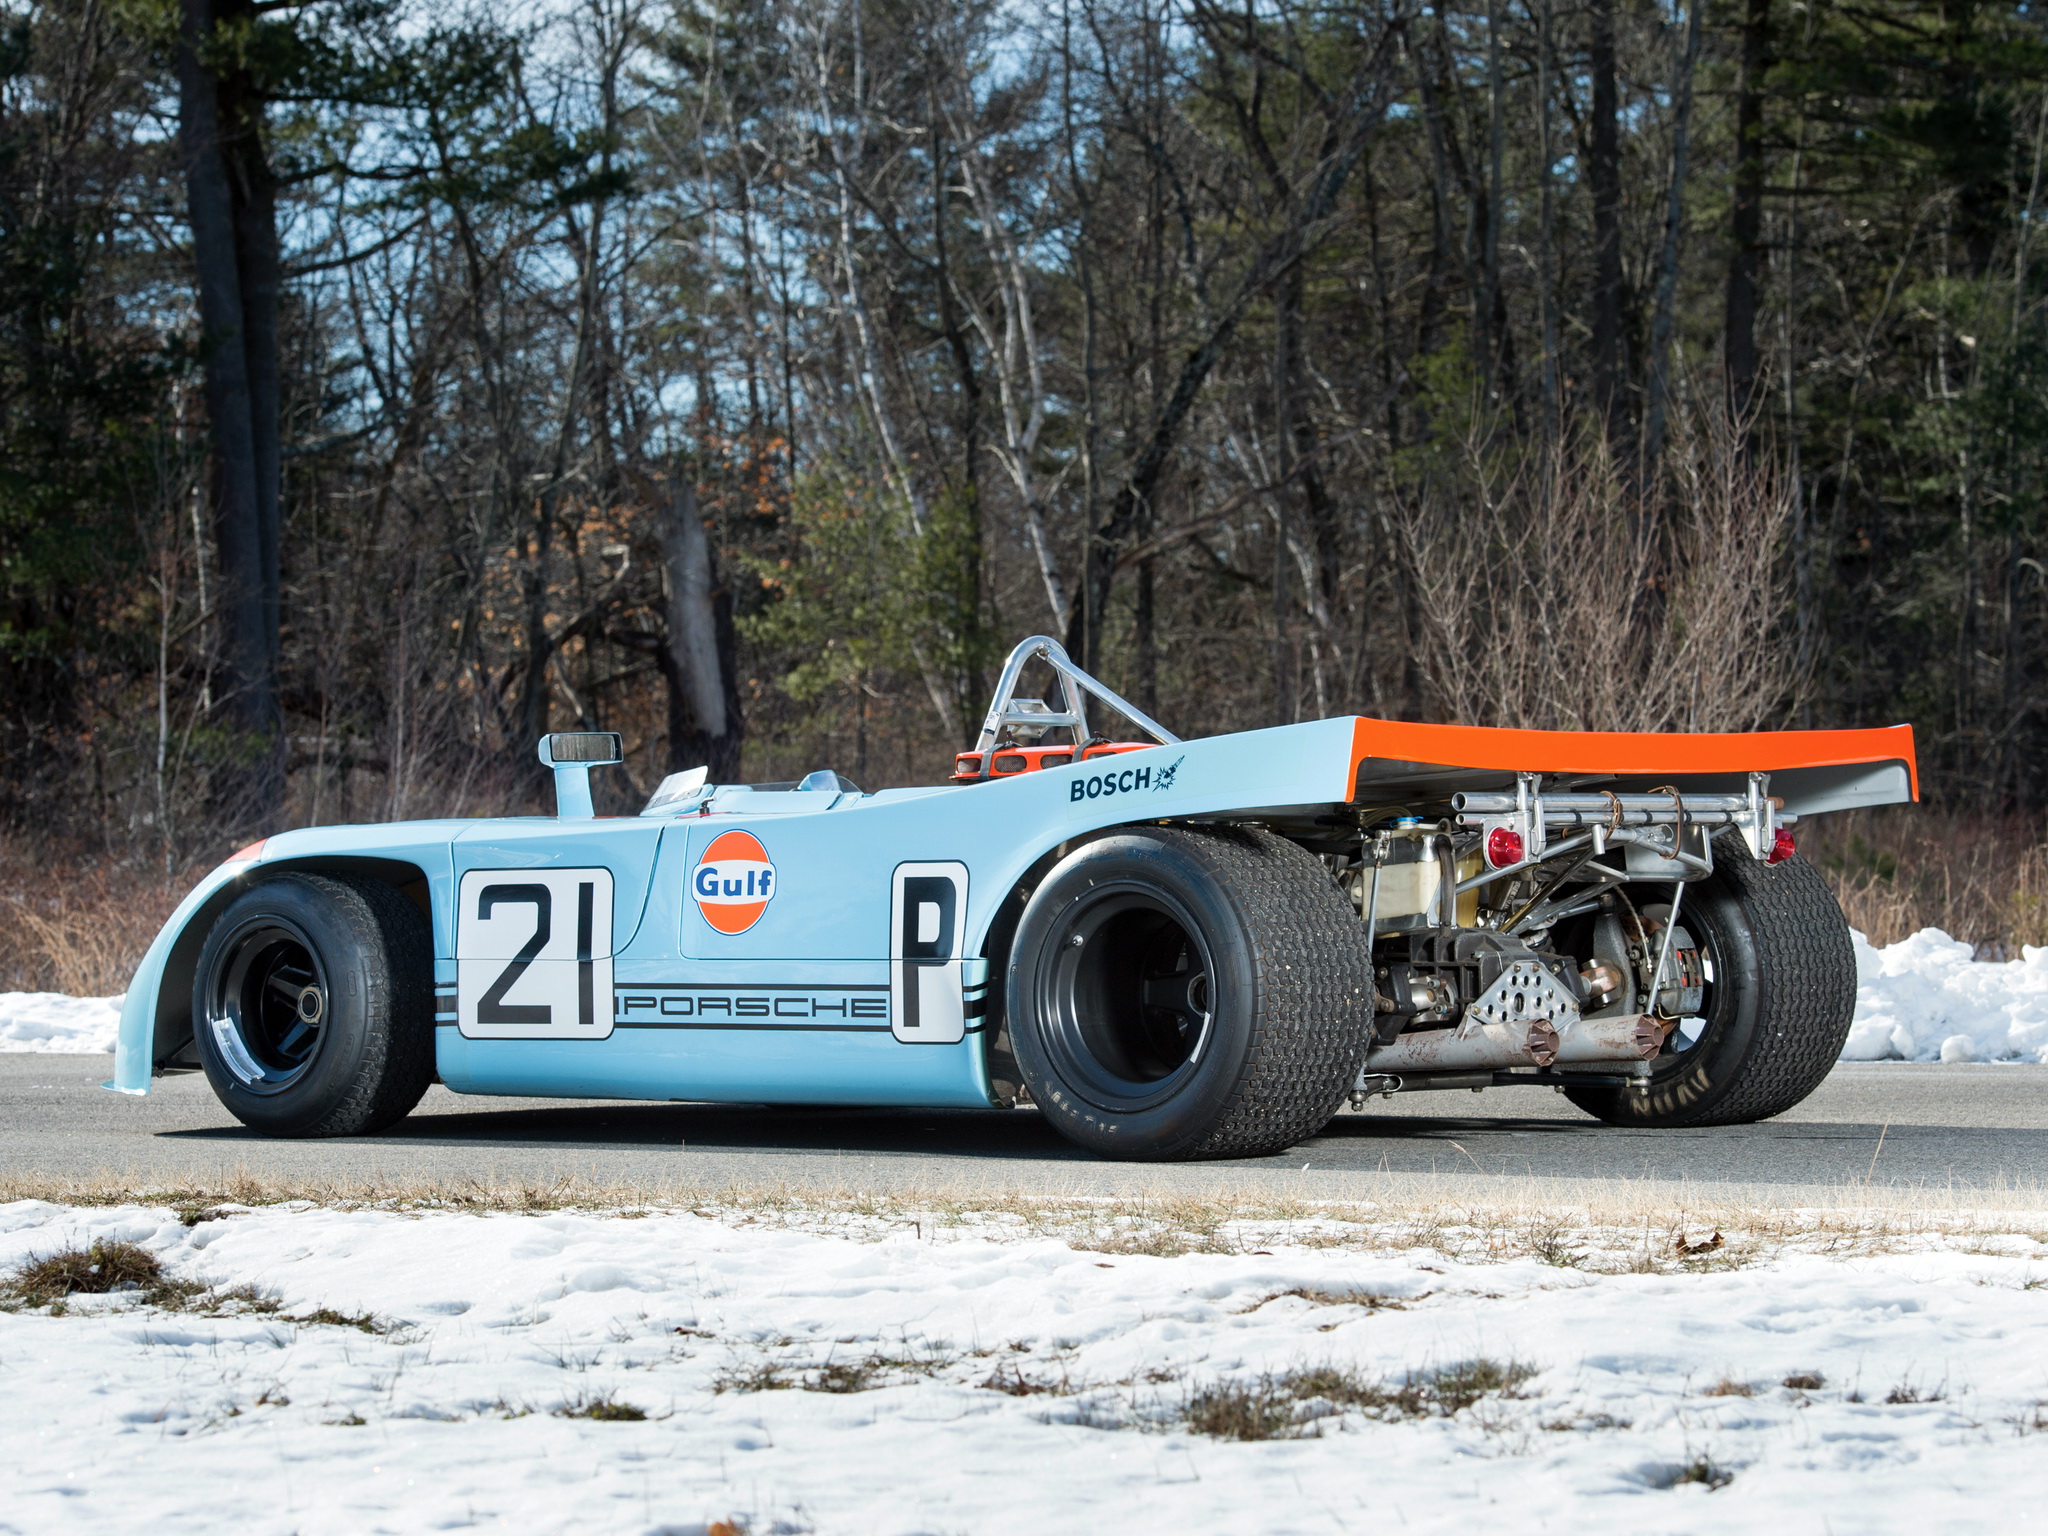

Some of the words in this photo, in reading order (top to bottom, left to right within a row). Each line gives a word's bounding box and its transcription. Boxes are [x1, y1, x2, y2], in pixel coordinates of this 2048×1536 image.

[1070, 766, 1151, 802] BOSCH
[695, 867, 772, 896] Gulf
[477, 882, 594, 1025] 21
[903, 876, 957, 1027] P
[624, 996, 887, 1018] PORSCHE
